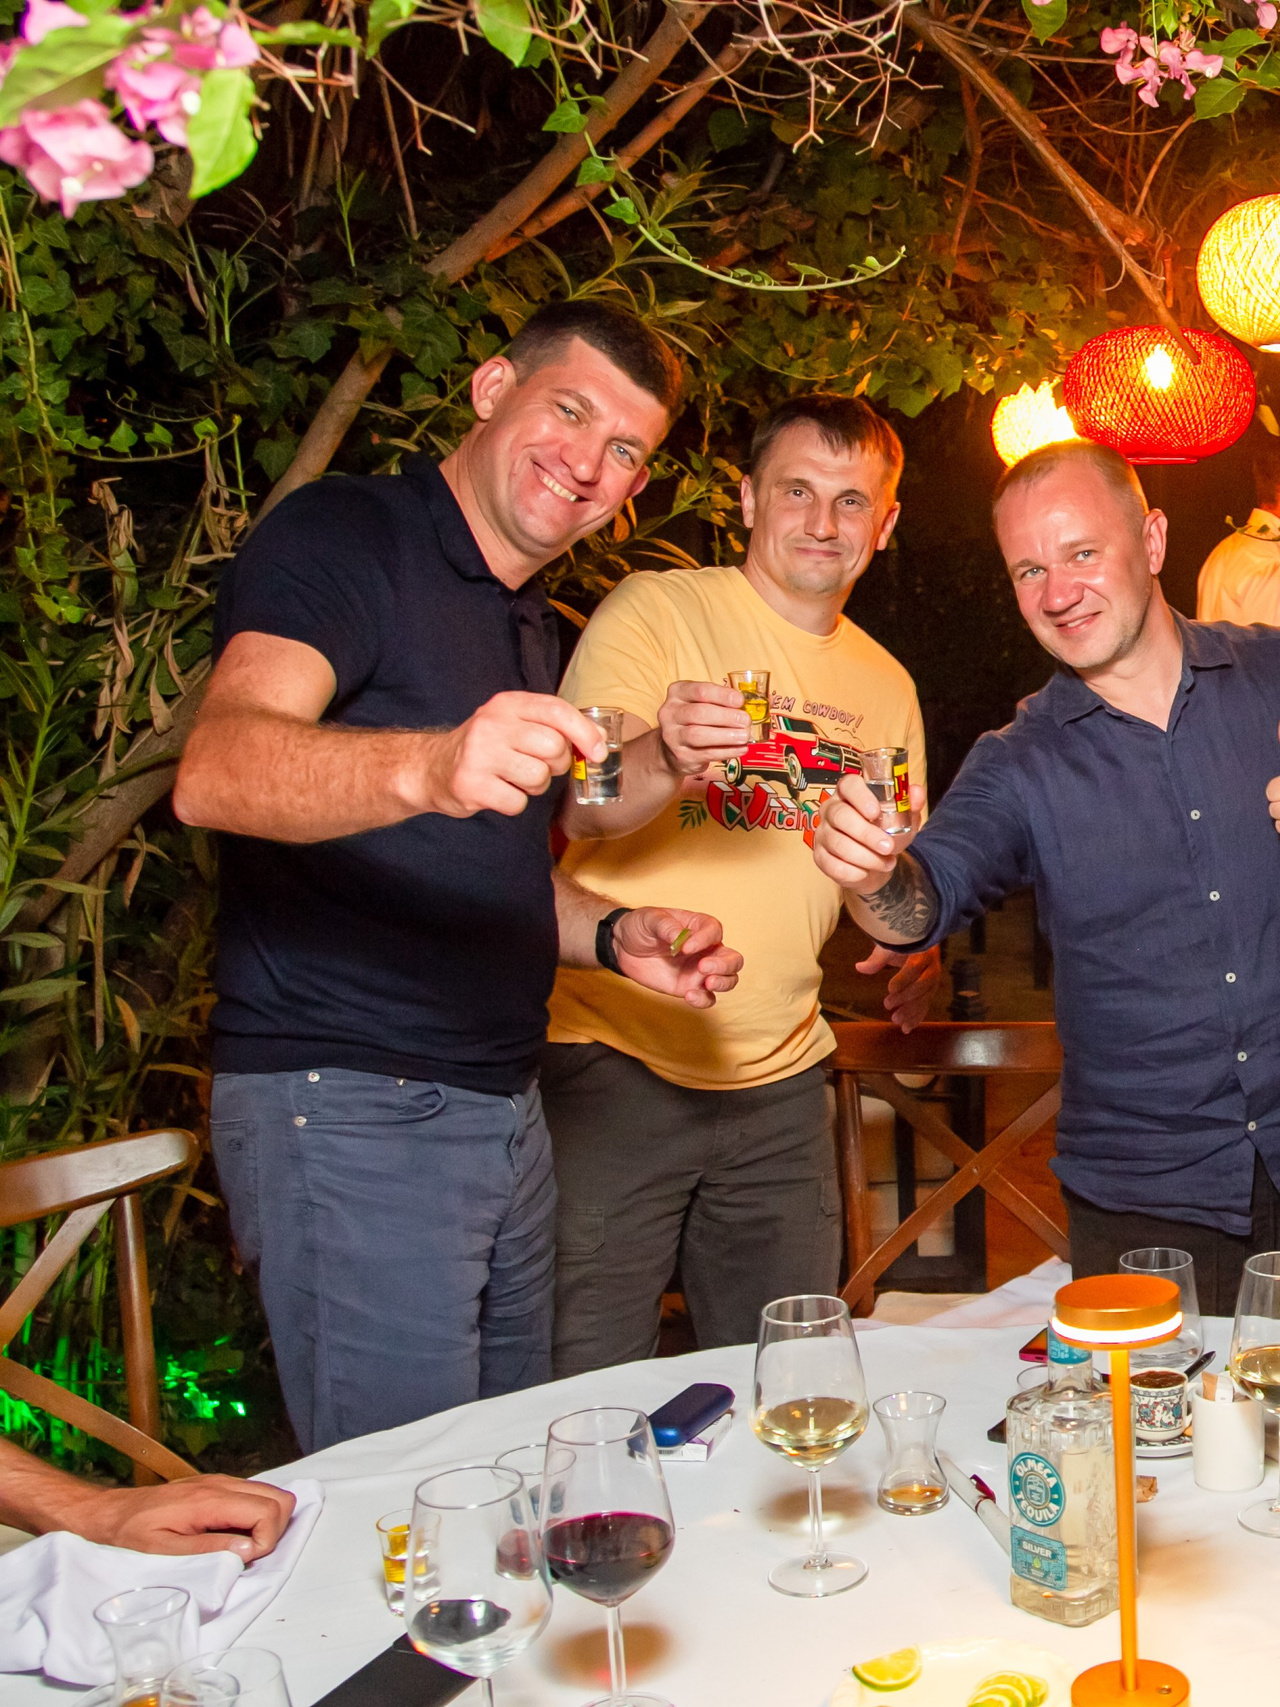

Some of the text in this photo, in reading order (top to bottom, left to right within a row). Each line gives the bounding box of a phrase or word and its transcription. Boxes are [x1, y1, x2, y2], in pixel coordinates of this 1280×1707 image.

[802, 700, 864, 734] COWBOY!
[707, 780, 826, 840] Wran
[1015, 1459, 1058, 1488] OLMECA
[1016, 1491, 1060, 1521] TEQUILA
[1022, 1541, 1052, 1559] SILVER
